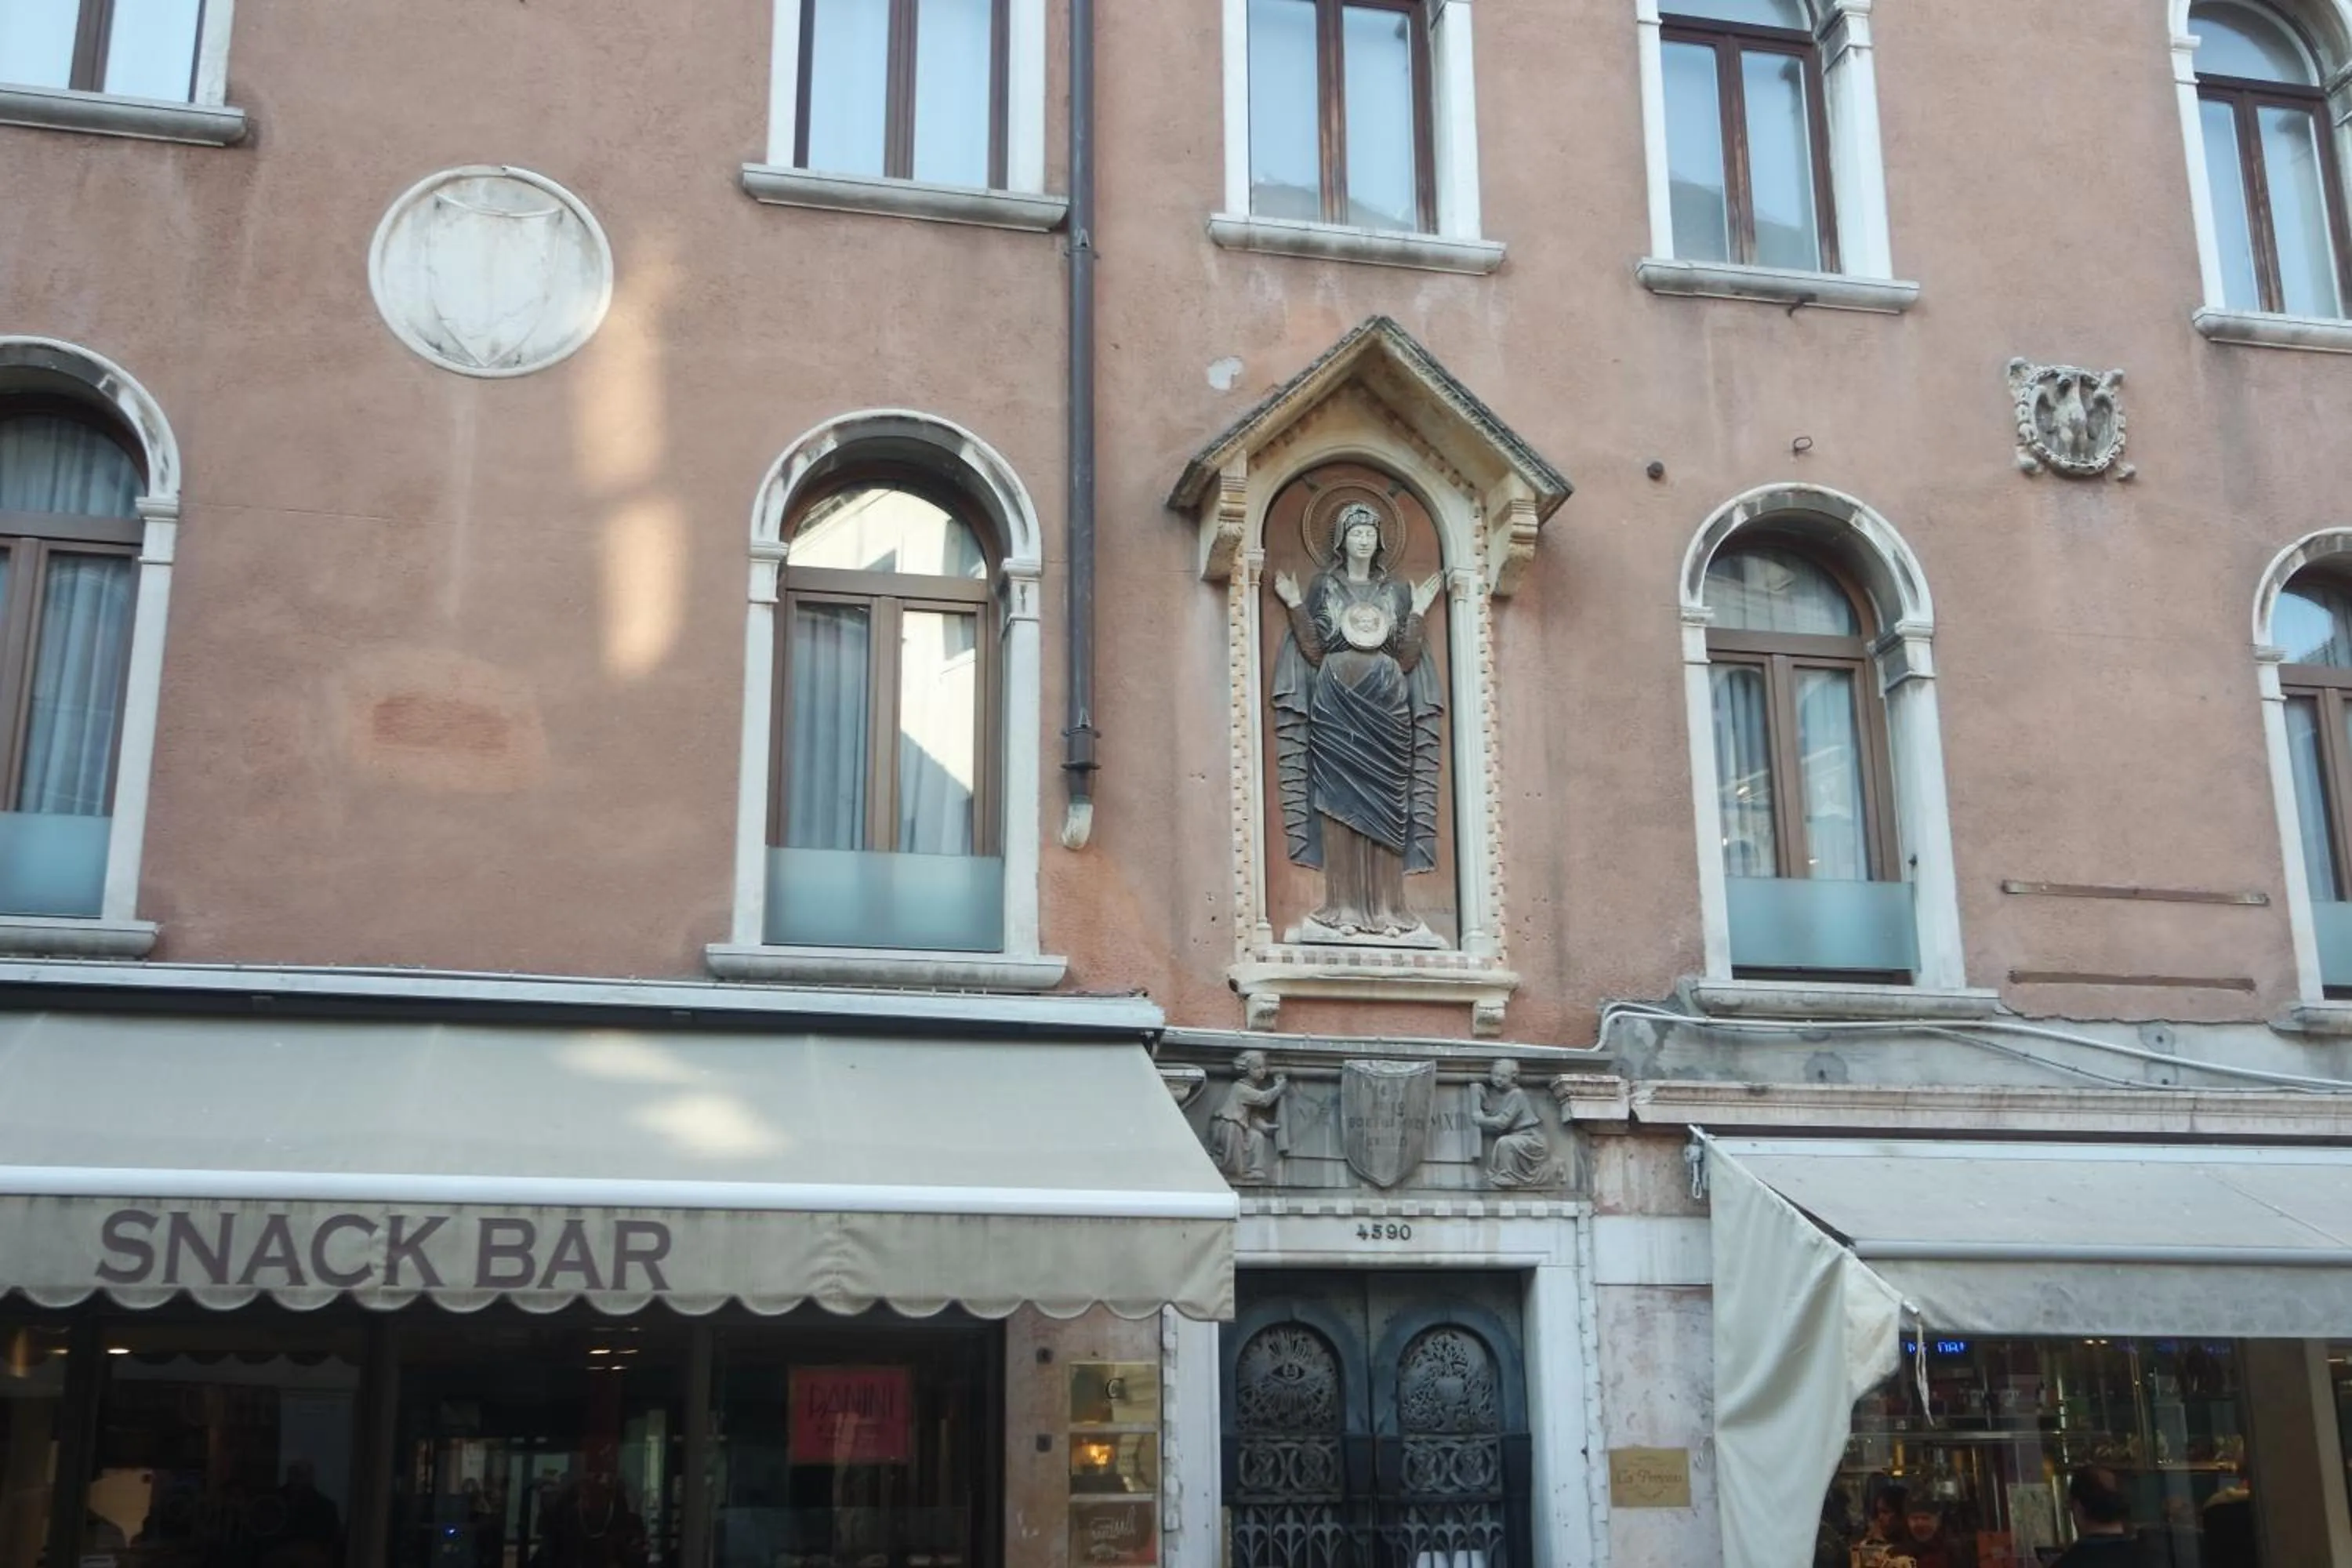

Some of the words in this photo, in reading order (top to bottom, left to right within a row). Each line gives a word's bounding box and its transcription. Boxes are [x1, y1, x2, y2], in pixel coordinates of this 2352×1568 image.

[96, 1210, 450, 1288] SNACK
[474, 1217, 673, 1291] BAR
[1355, 1223, 1412, 1241] 4590
